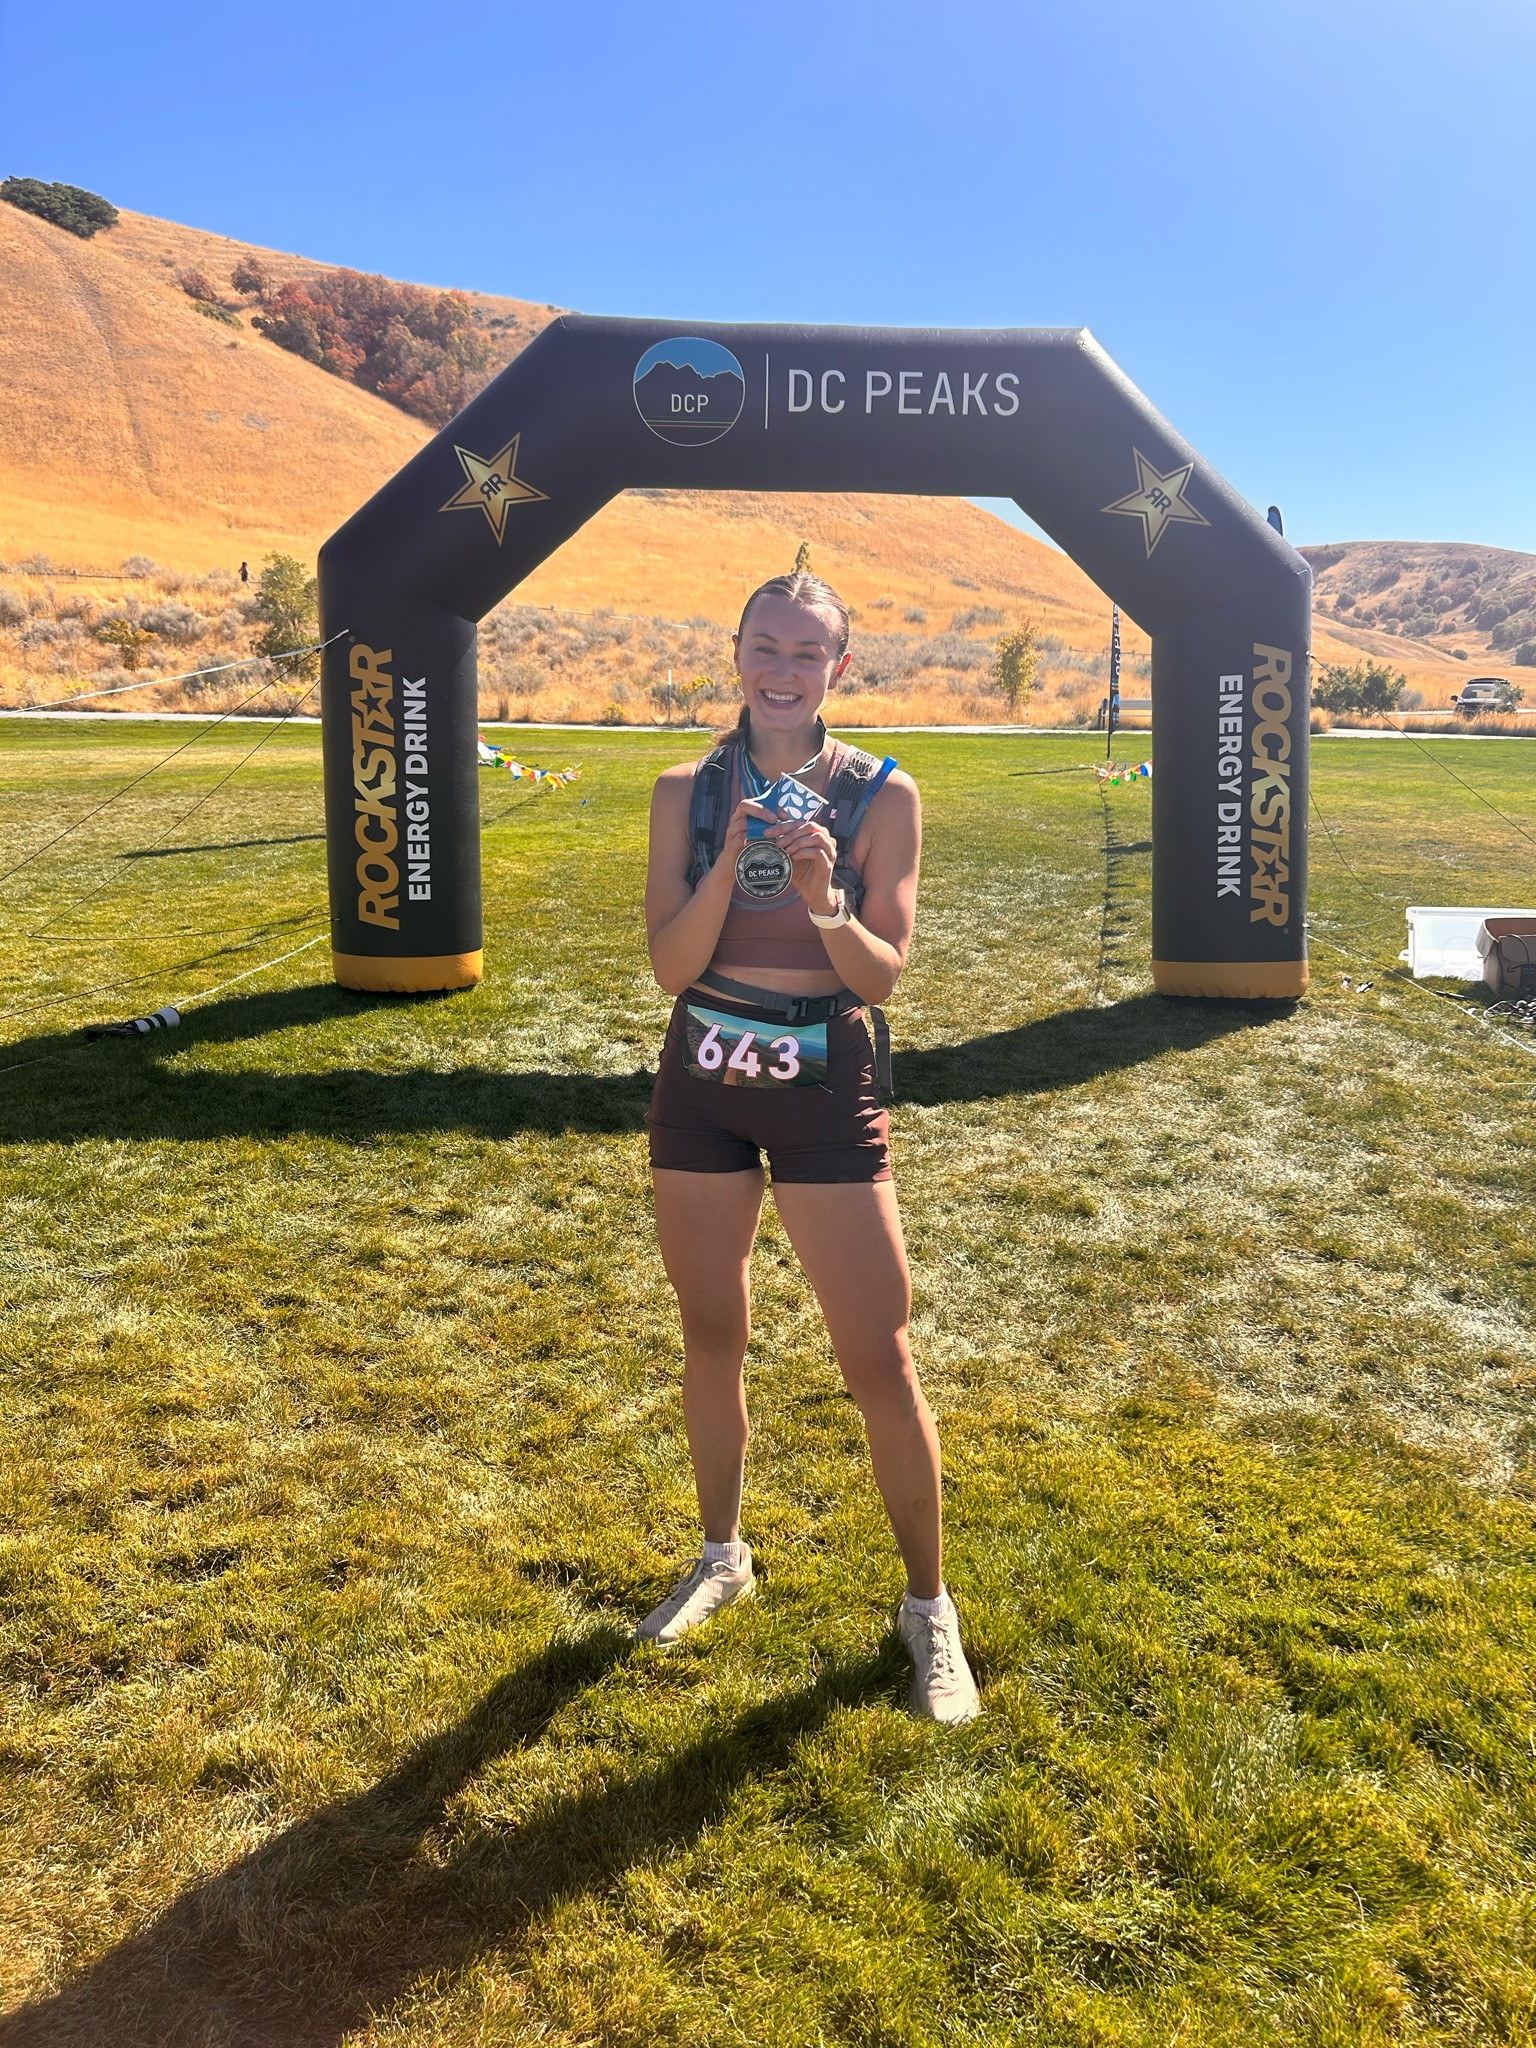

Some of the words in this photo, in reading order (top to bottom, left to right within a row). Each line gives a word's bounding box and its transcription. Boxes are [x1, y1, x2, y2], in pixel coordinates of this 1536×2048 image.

[670, 393, 710, 414] DCP
[787, 368, 847, 414] DC
[865, 370, 1021, 417] PEAKS
[402, 676, 430, 776] DRINK
[1216, 674, 1244, 797] ENERGY
[349, 643, 401, 931] ROCKSTAR
[1250, 642, 1293, 927] ROCKSTAR
[405, 781, 432, 901] ENERGY
[748, 870, 758, 878] DC
[758, 868, 781, 877] PEAKS
[1216, 802, 1243, 898] DRINK
[697, 1022, 802, 1081] 643
